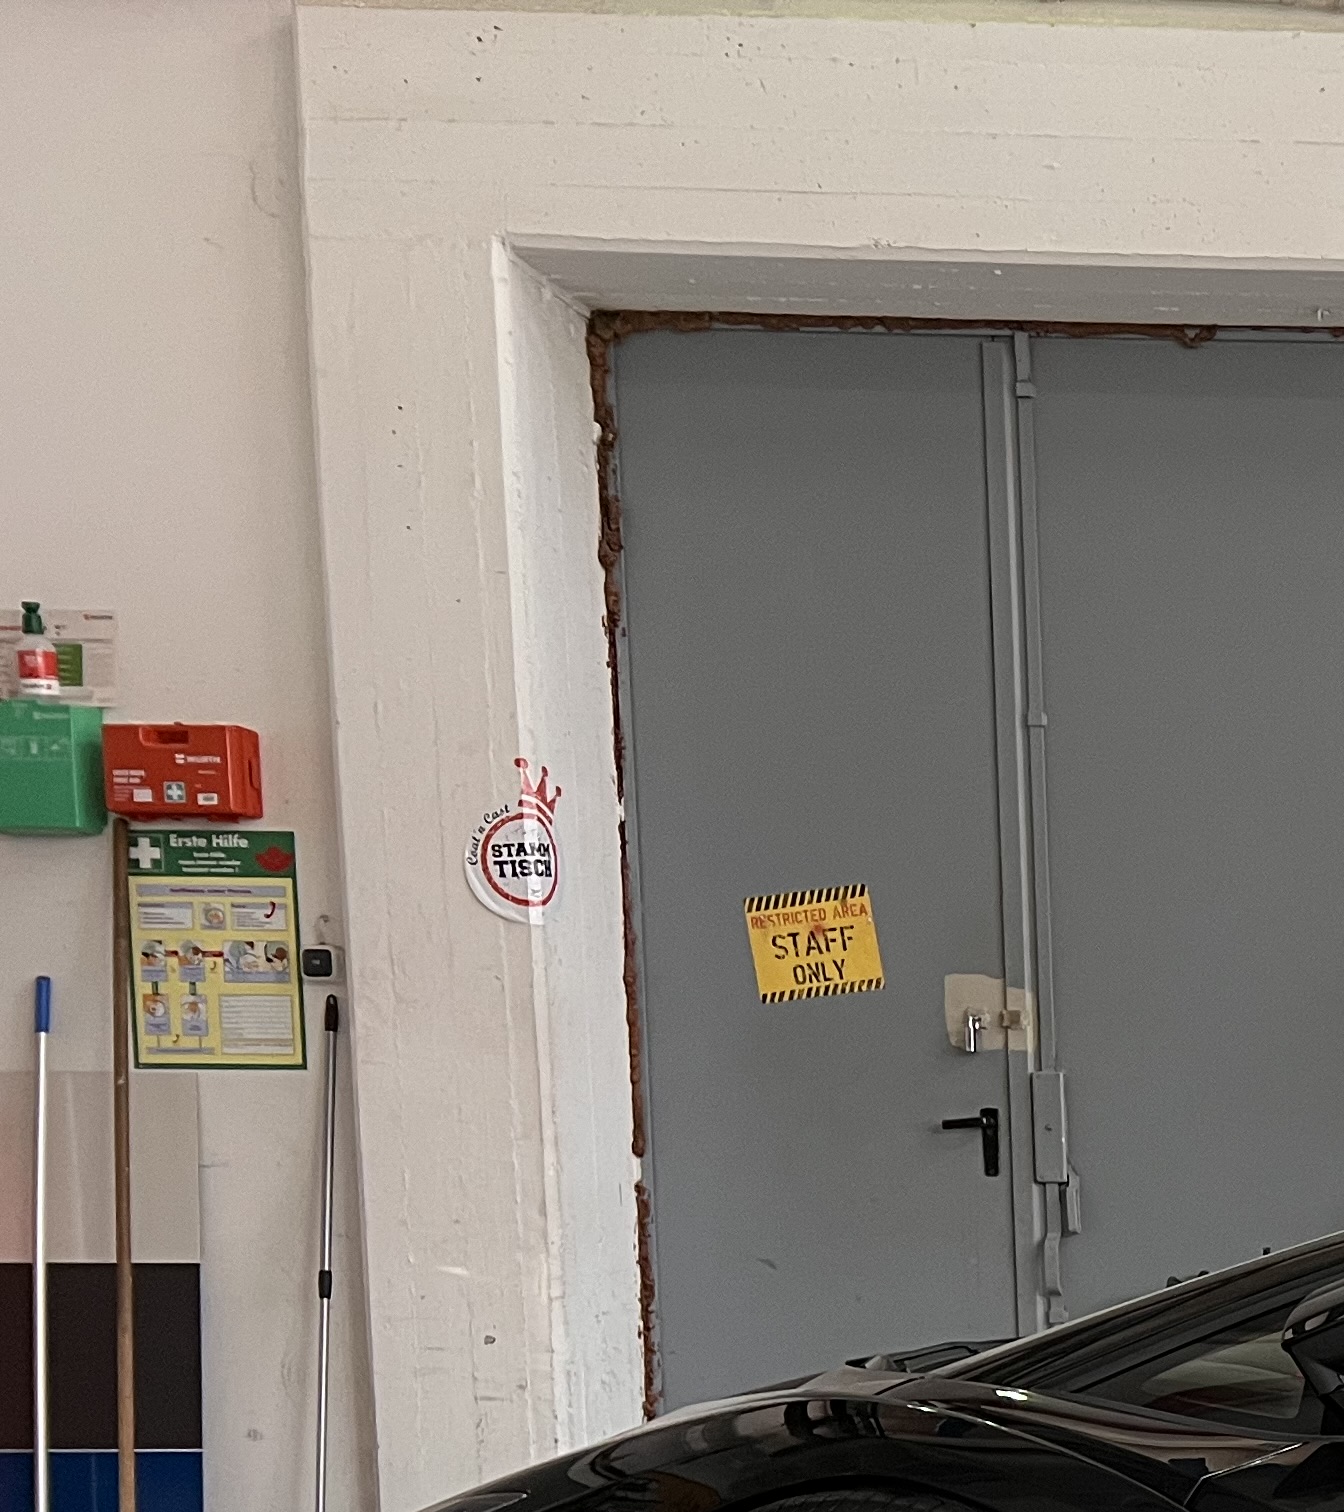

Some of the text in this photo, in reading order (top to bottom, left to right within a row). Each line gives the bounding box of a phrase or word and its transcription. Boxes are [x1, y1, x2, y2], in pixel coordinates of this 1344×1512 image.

[169, 833, 249, 848] Erste Hilfe
[750, 902, 869, 930] RESTRICTED AREA
[771, 925, 855, 960] STAFF
[792, 958, 846, 986] ONLY
